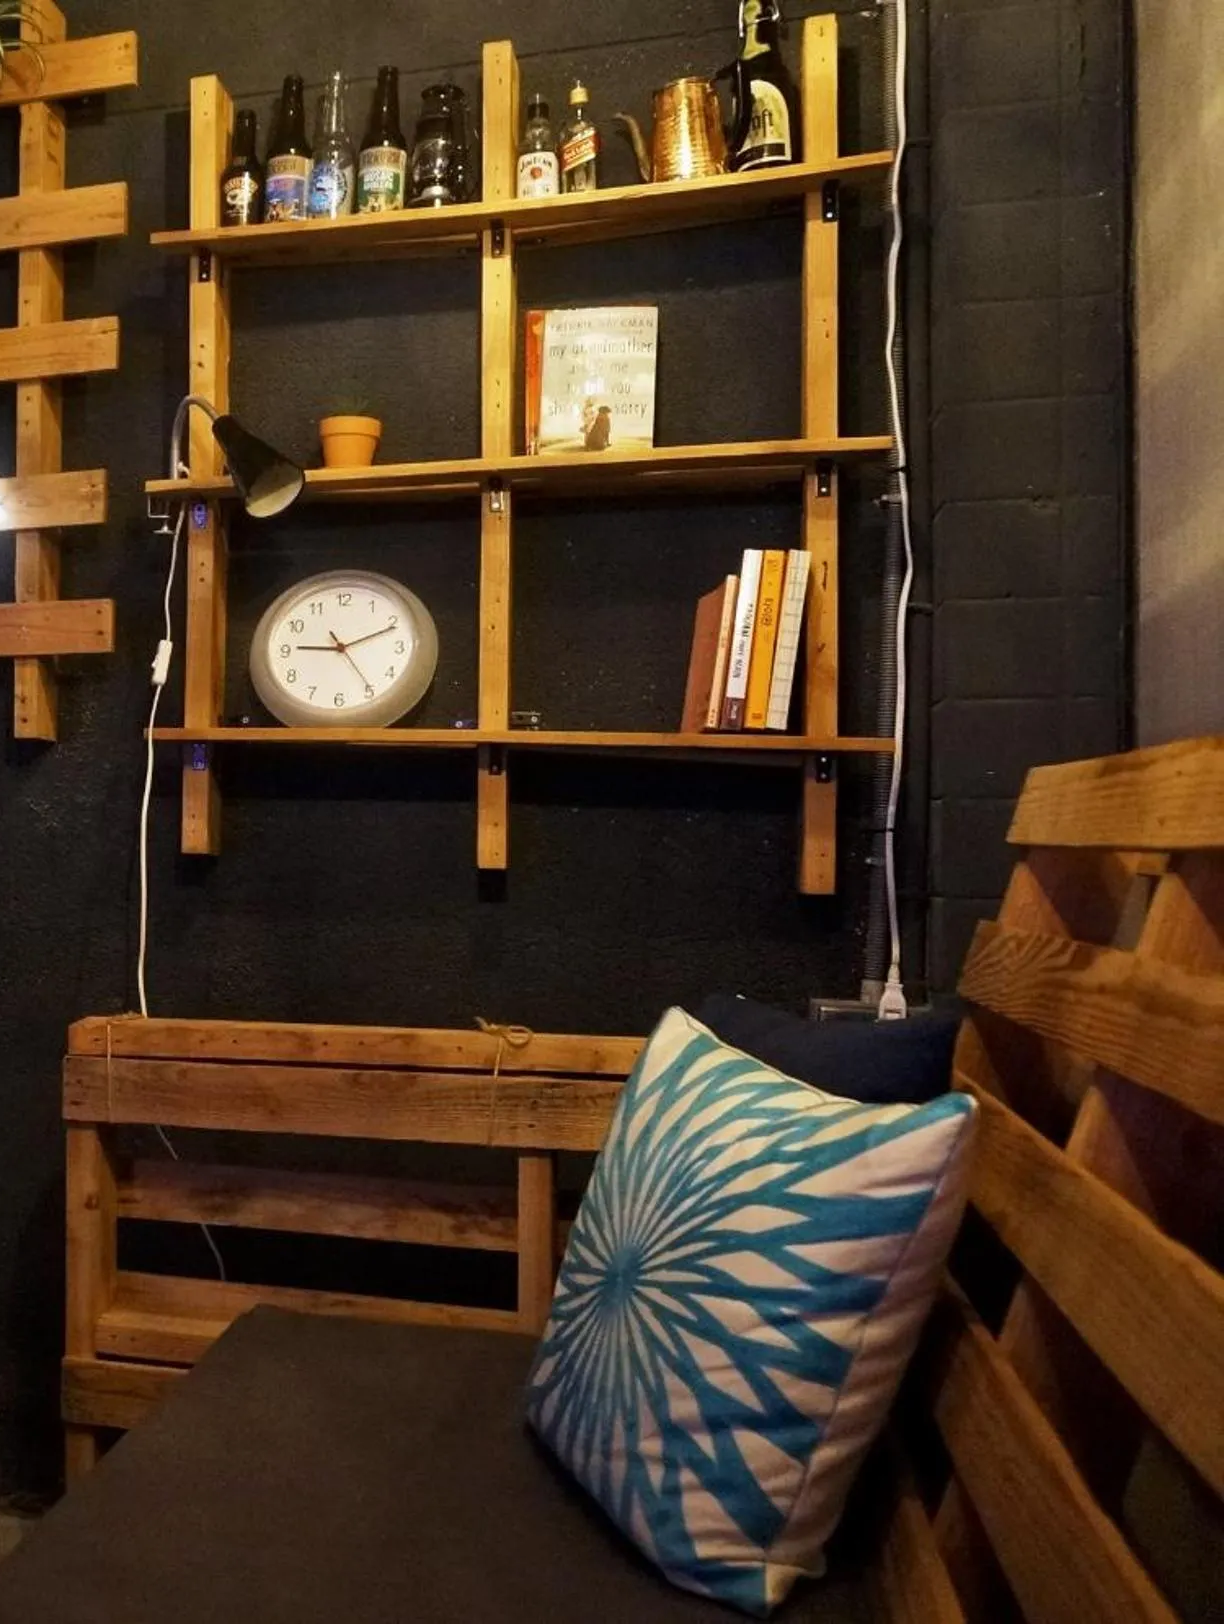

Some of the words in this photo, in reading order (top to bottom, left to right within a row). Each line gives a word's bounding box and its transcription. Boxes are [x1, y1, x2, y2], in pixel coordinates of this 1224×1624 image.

[549, 345, 567, 360] my
[572, 337, 653, 357] grdmother
[610, 362, 629, 374] me
[614, 402, 648, 419] sorry
[337, 593, 352, 607] 12
[369, 600, 375, 613] 1
[309, 602, 324, 616] 11
[289, 619, 305, 634] 10
[387, 615, 400, 629] 2
[280, 644, 291, 658] 9
[395, 641, 404, 654] 3
[286, 669, 296, 683] 8
[384, 665, 395, 680] 4
[307, 685, 317, 700] 7
[364, 685, 375, 700] 5
[334, 693, 345, 707] 6
